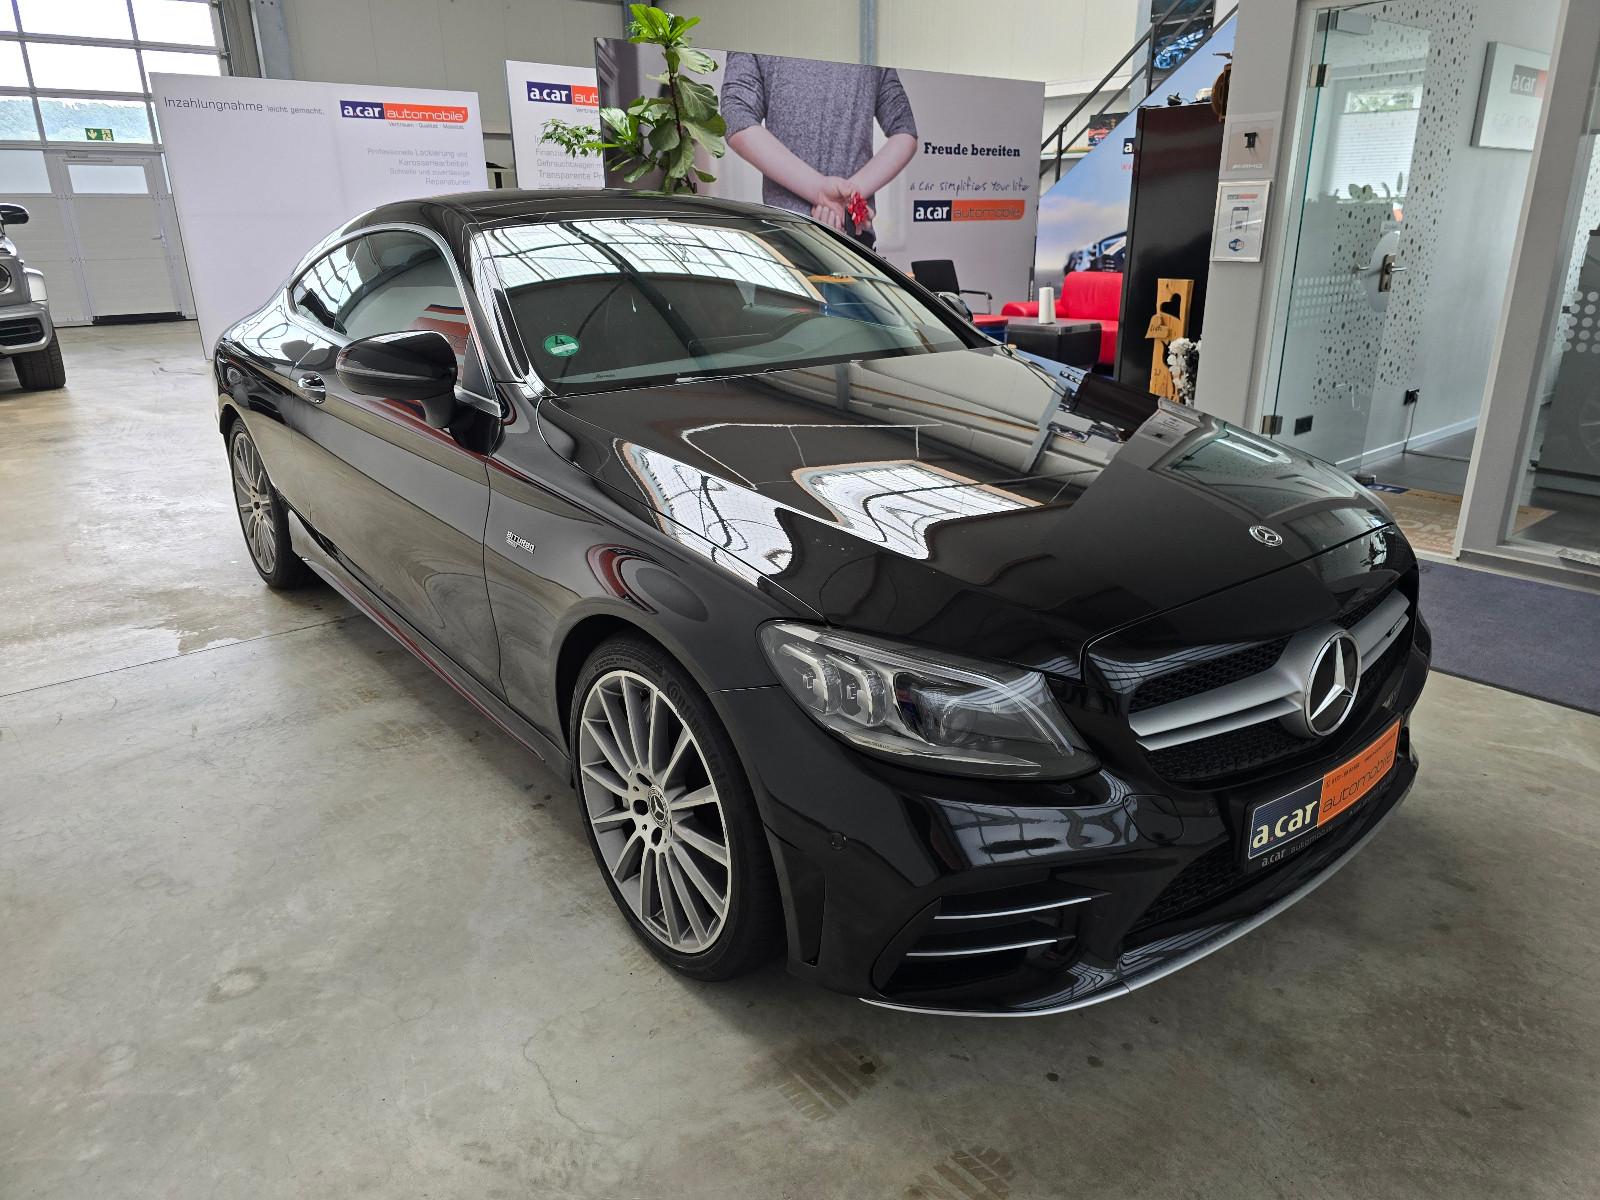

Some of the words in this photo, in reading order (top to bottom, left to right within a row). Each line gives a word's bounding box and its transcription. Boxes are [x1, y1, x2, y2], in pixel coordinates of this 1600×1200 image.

[530, 87, 569, 102] a.car
[164, 96, 263, 112] Inzahlungnahme
[344, 105, 382, 118] a.car
[387, 108, 464, 121] automobile
[924, 142, 969, 156] Freude
[971, 144, 1021, 157] bereiten
[915, 206, 950, 220] a.car
[554, 335, 566, 346] 4
[1252, 800, 1318, 849] a.car
[1322, 750, 1393, 813] automobile
[1261, 849, 1287, 868] a.car
